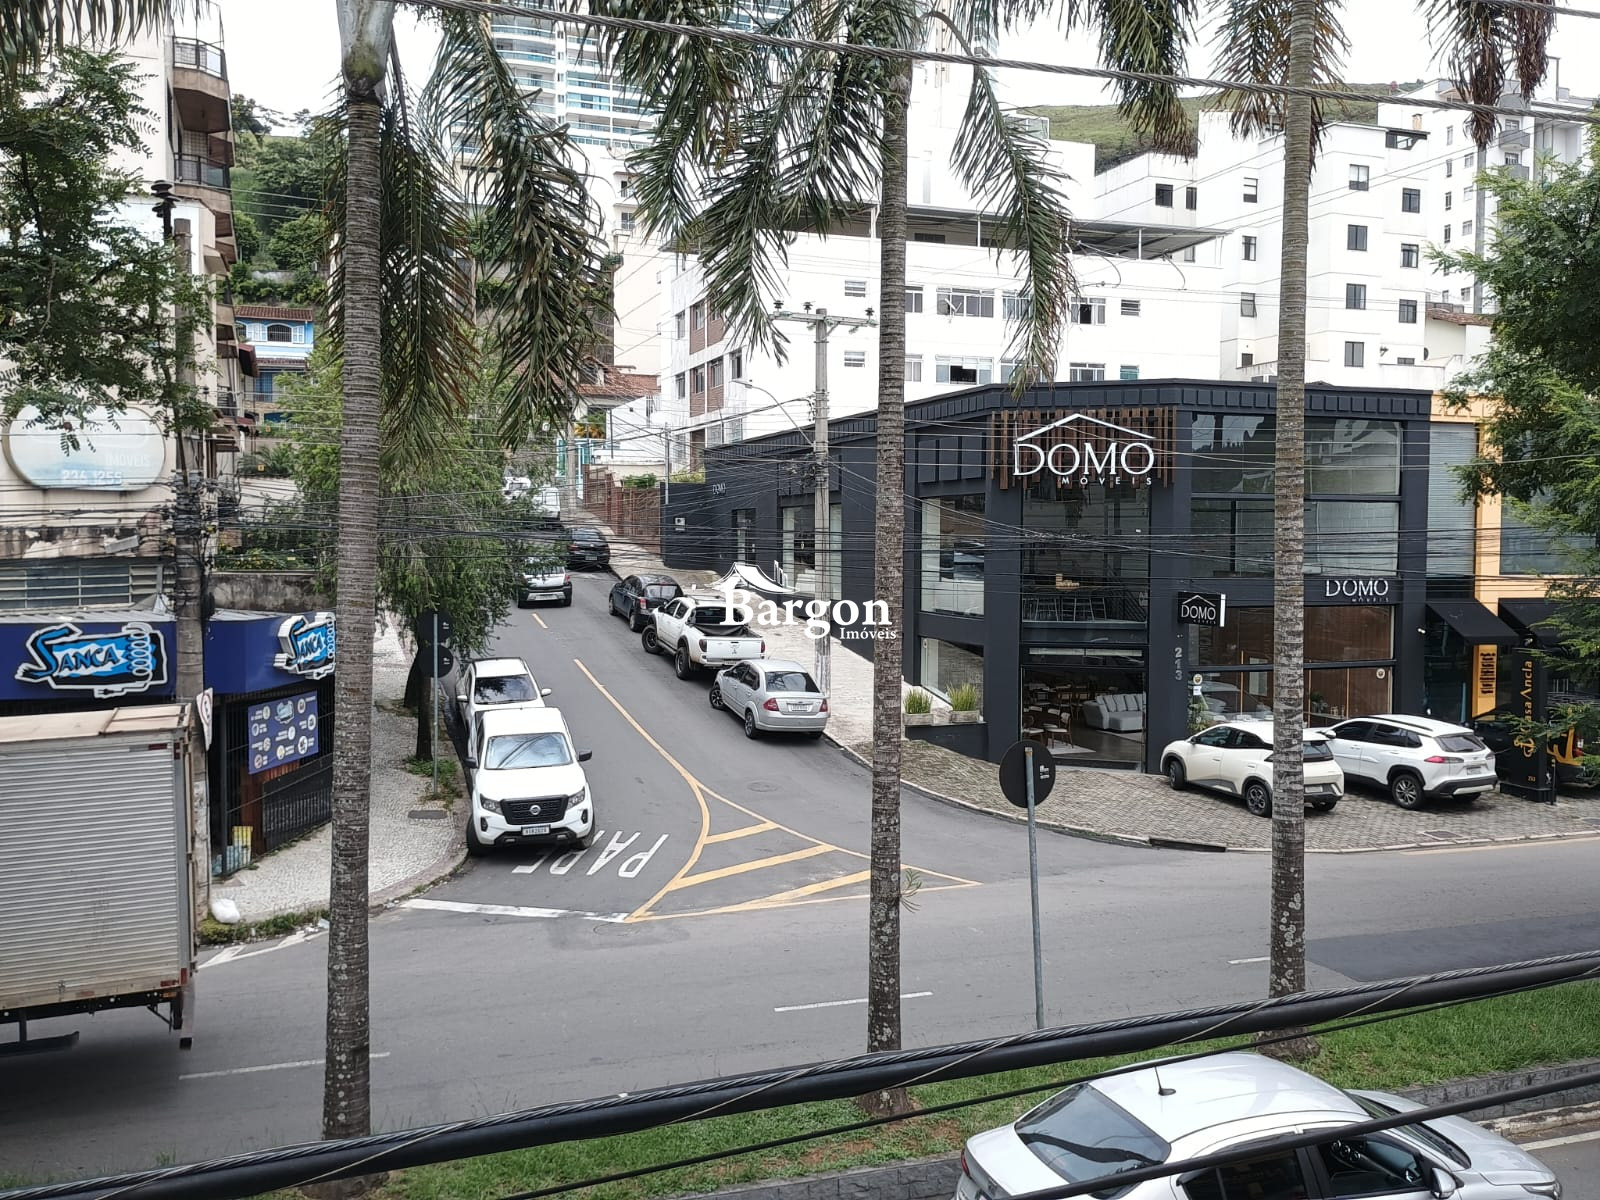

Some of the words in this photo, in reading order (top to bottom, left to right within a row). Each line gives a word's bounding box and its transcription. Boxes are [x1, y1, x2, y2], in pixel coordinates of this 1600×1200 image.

[1013, 442, 1155, 476] DOMO
[1325, 578, 1389, 597] DOMO
[1181, 604, 1217, 621] DOMO
[28, 627, 121, 678] SANCA
[1174, 646, 1183, 681] 213
